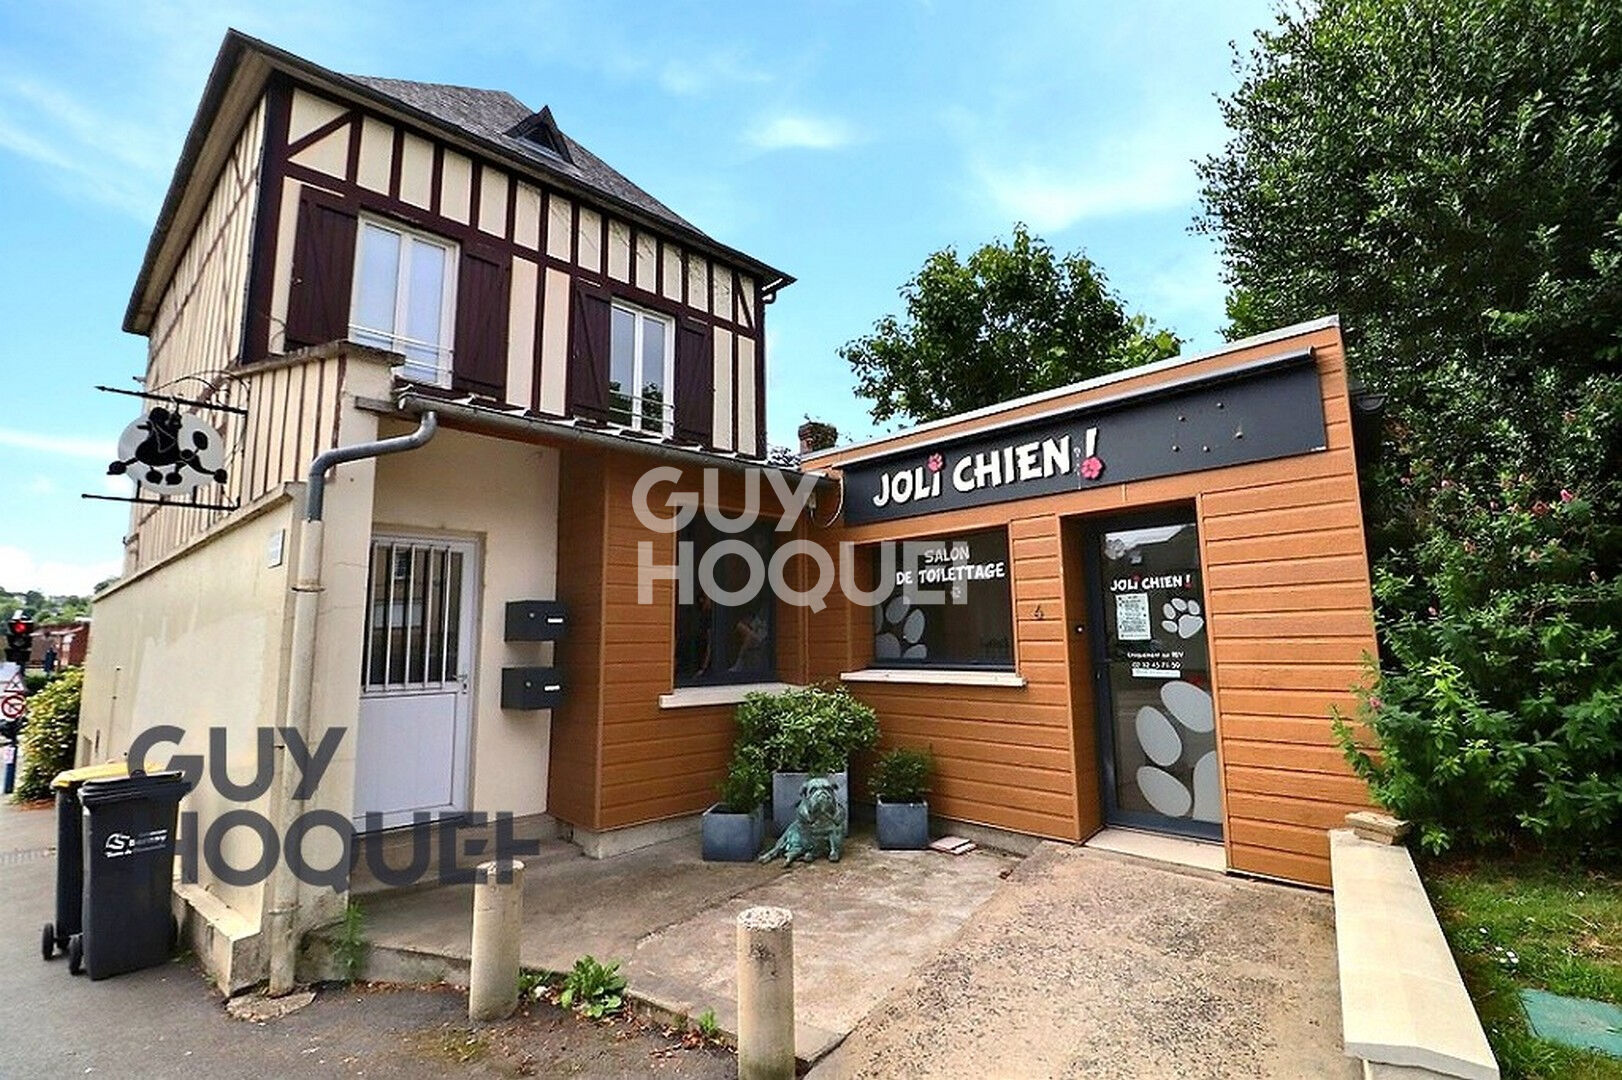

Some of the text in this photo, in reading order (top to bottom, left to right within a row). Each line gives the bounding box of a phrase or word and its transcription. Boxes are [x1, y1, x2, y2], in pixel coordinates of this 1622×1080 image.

[952, 434, 1072, 492] CHIEN
[924, 545, 970, 563] SALON
[896, 571, 913, 585] DE
[1141, 575, 1183, 590] CHIEN
